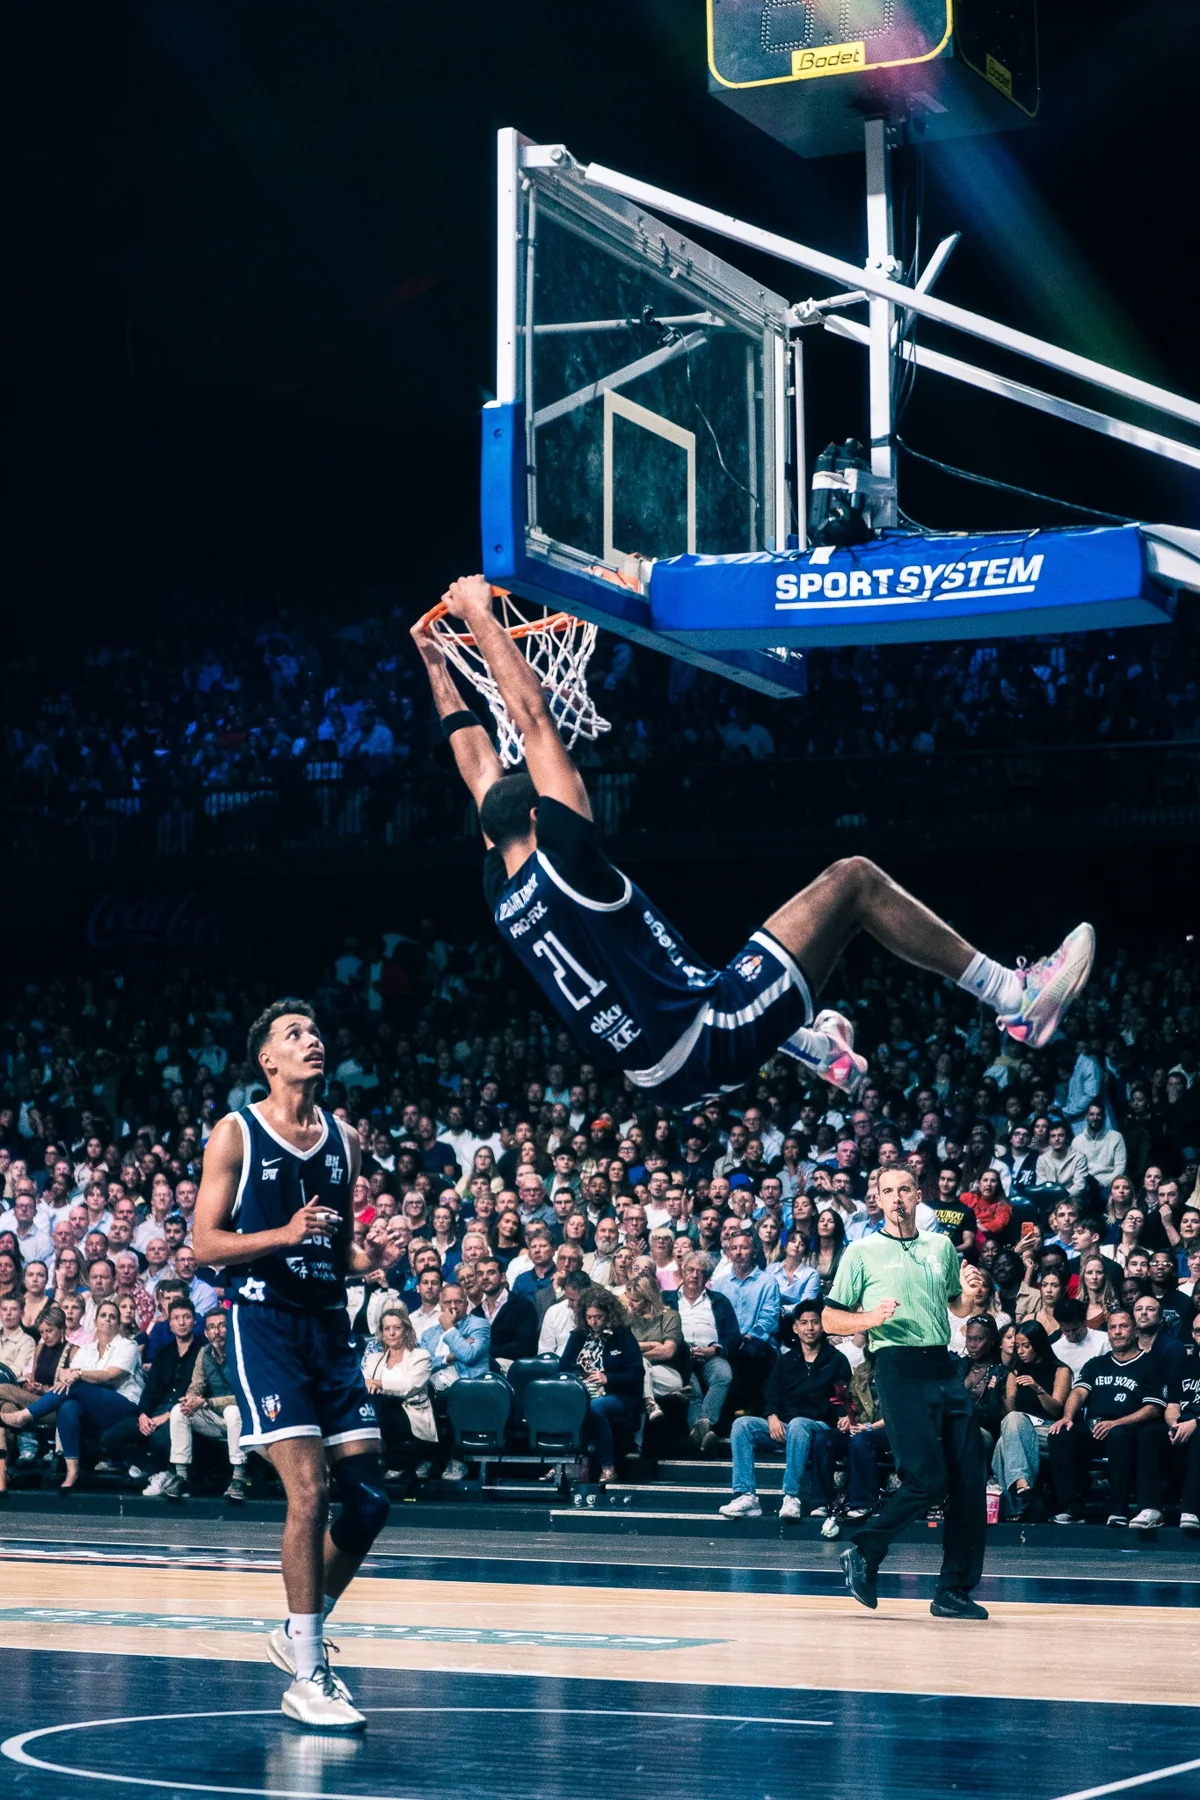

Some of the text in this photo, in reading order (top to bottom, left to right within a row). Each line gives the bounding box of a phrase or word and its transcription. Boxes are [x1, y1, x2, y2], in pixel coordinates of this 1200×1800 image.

[797, 48, 860, 71] Bodet
[643, 910, 684, 967] mega
[532, 930, 607, 1011] 21
[607, 1019, 642, 1052] KFC
[1113, 1375, 1139, 1392] YORK
